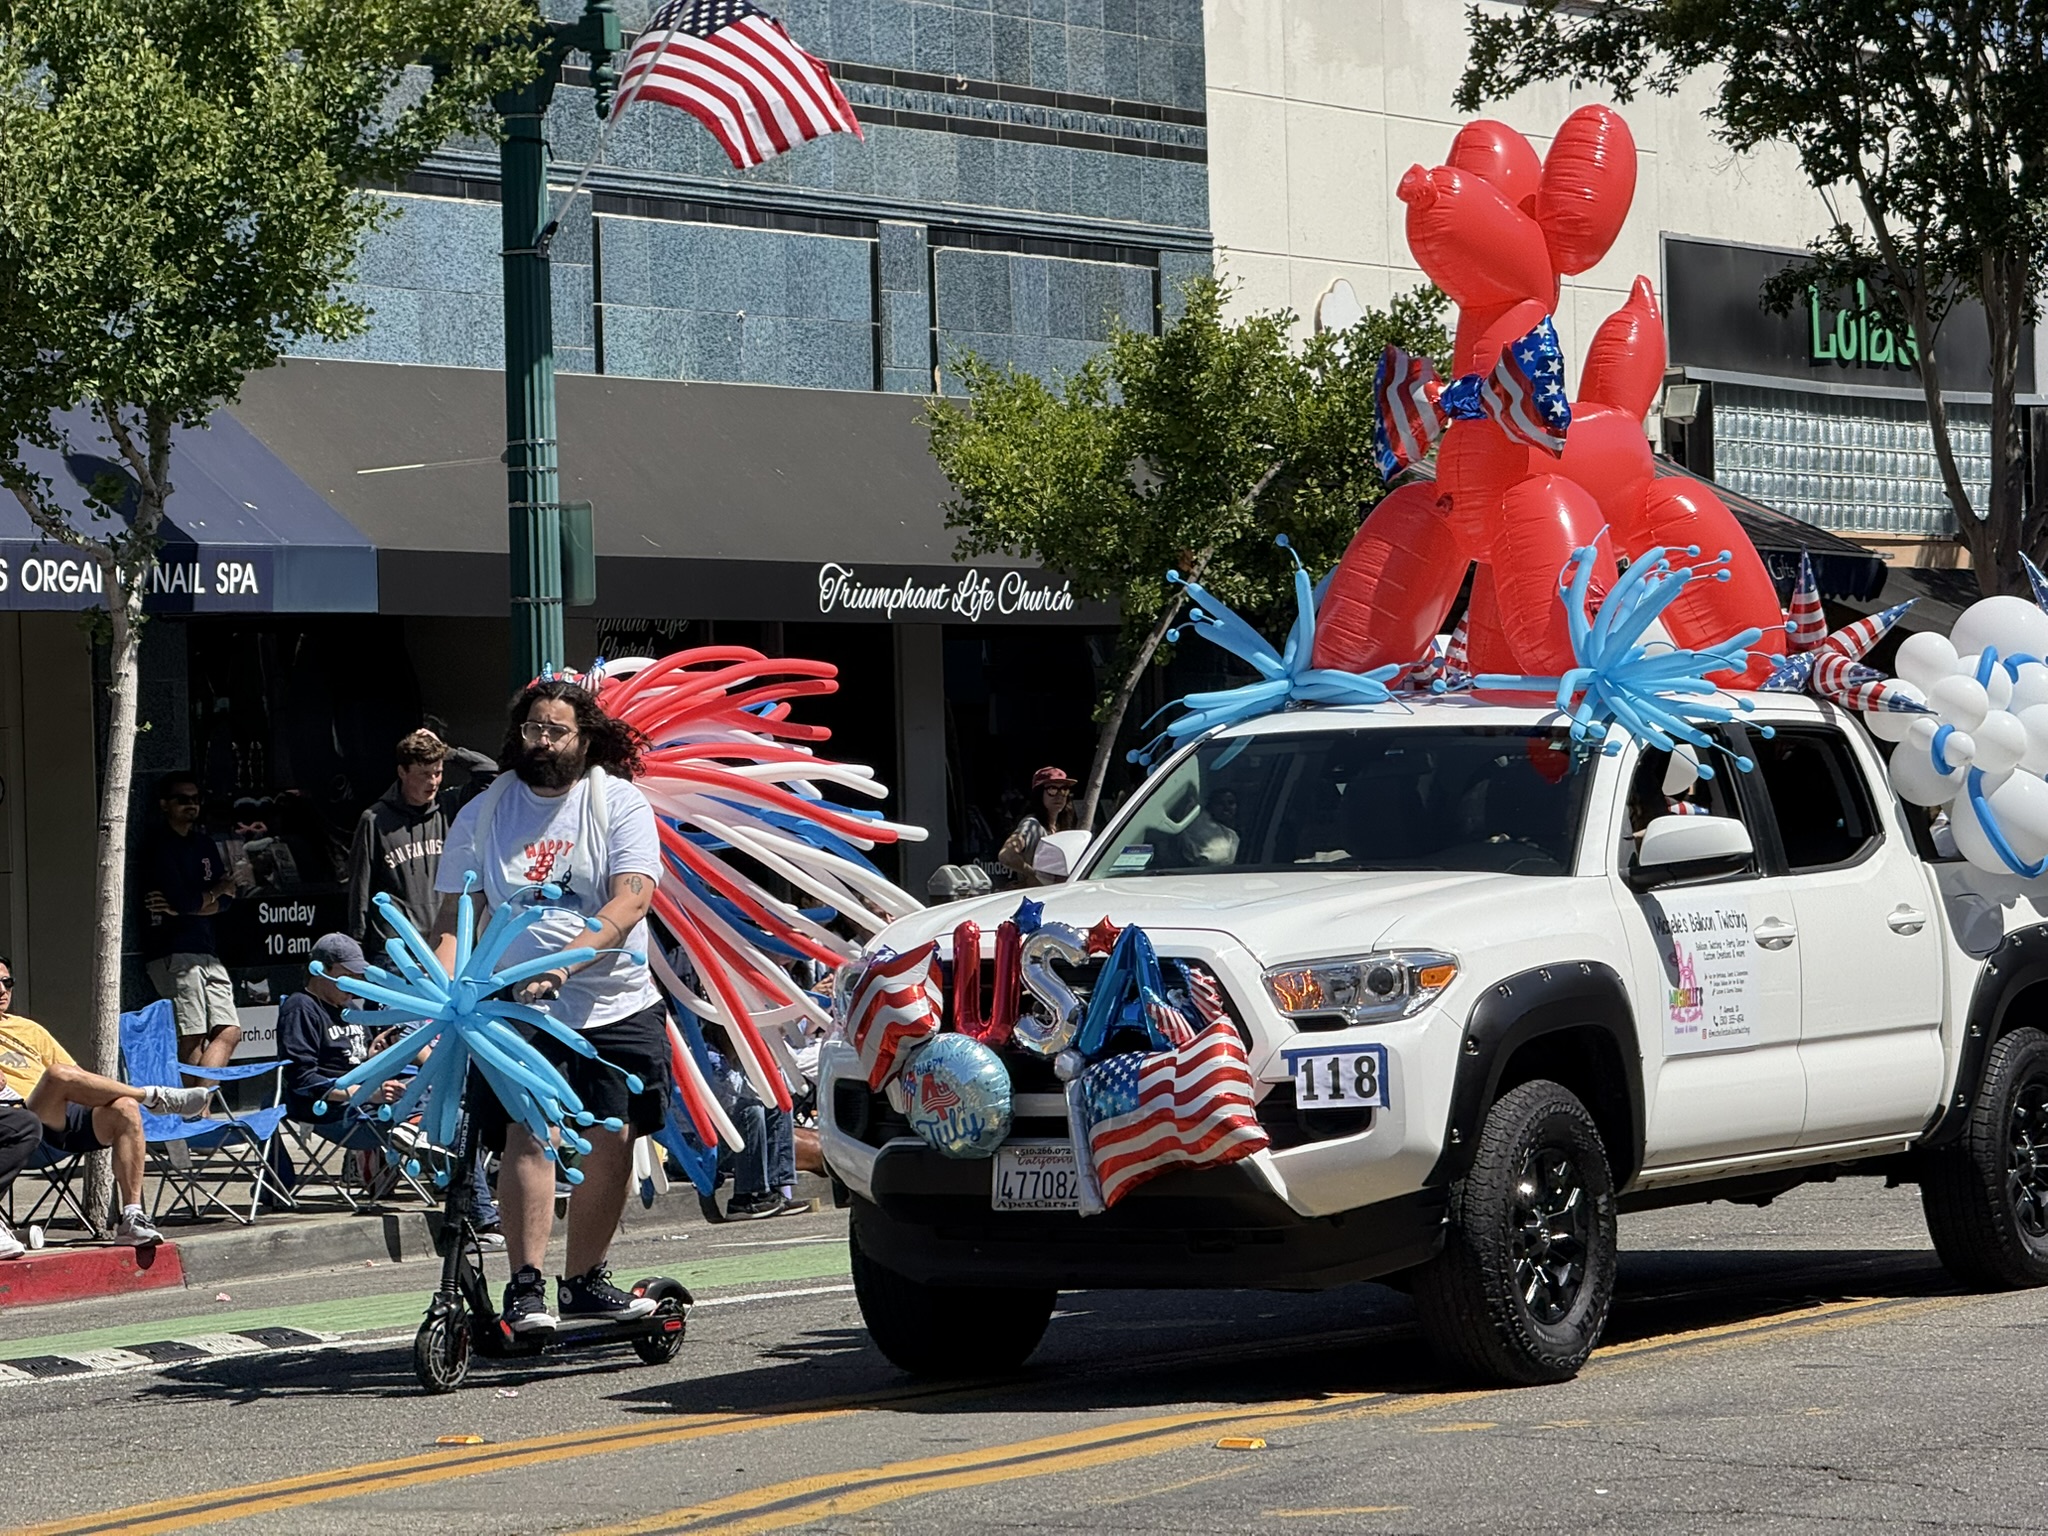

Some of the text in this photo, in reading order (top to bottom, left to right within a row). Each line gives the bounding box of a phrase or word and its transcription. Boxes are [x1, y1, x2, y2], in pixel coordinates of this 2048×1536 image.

[153, 562, 206, 594] NAIL
[216, 561, 259, 594] SPA
[819, 562, 1074, 622] Triumphant Life Church
[525, 839, 575, 859] HAPPY
[258, 901, 316, 926] Sunday
[264, 934, 311, 955] 10 am
[953, 919, 1174, 1058] USA
[240, 1026, 277, 1042] rch.or
[913, 1056, 944, 1077] HAPPY
[1301, 1055, 1378, 1101] 118
[915, 1108, 986, 1151] July
